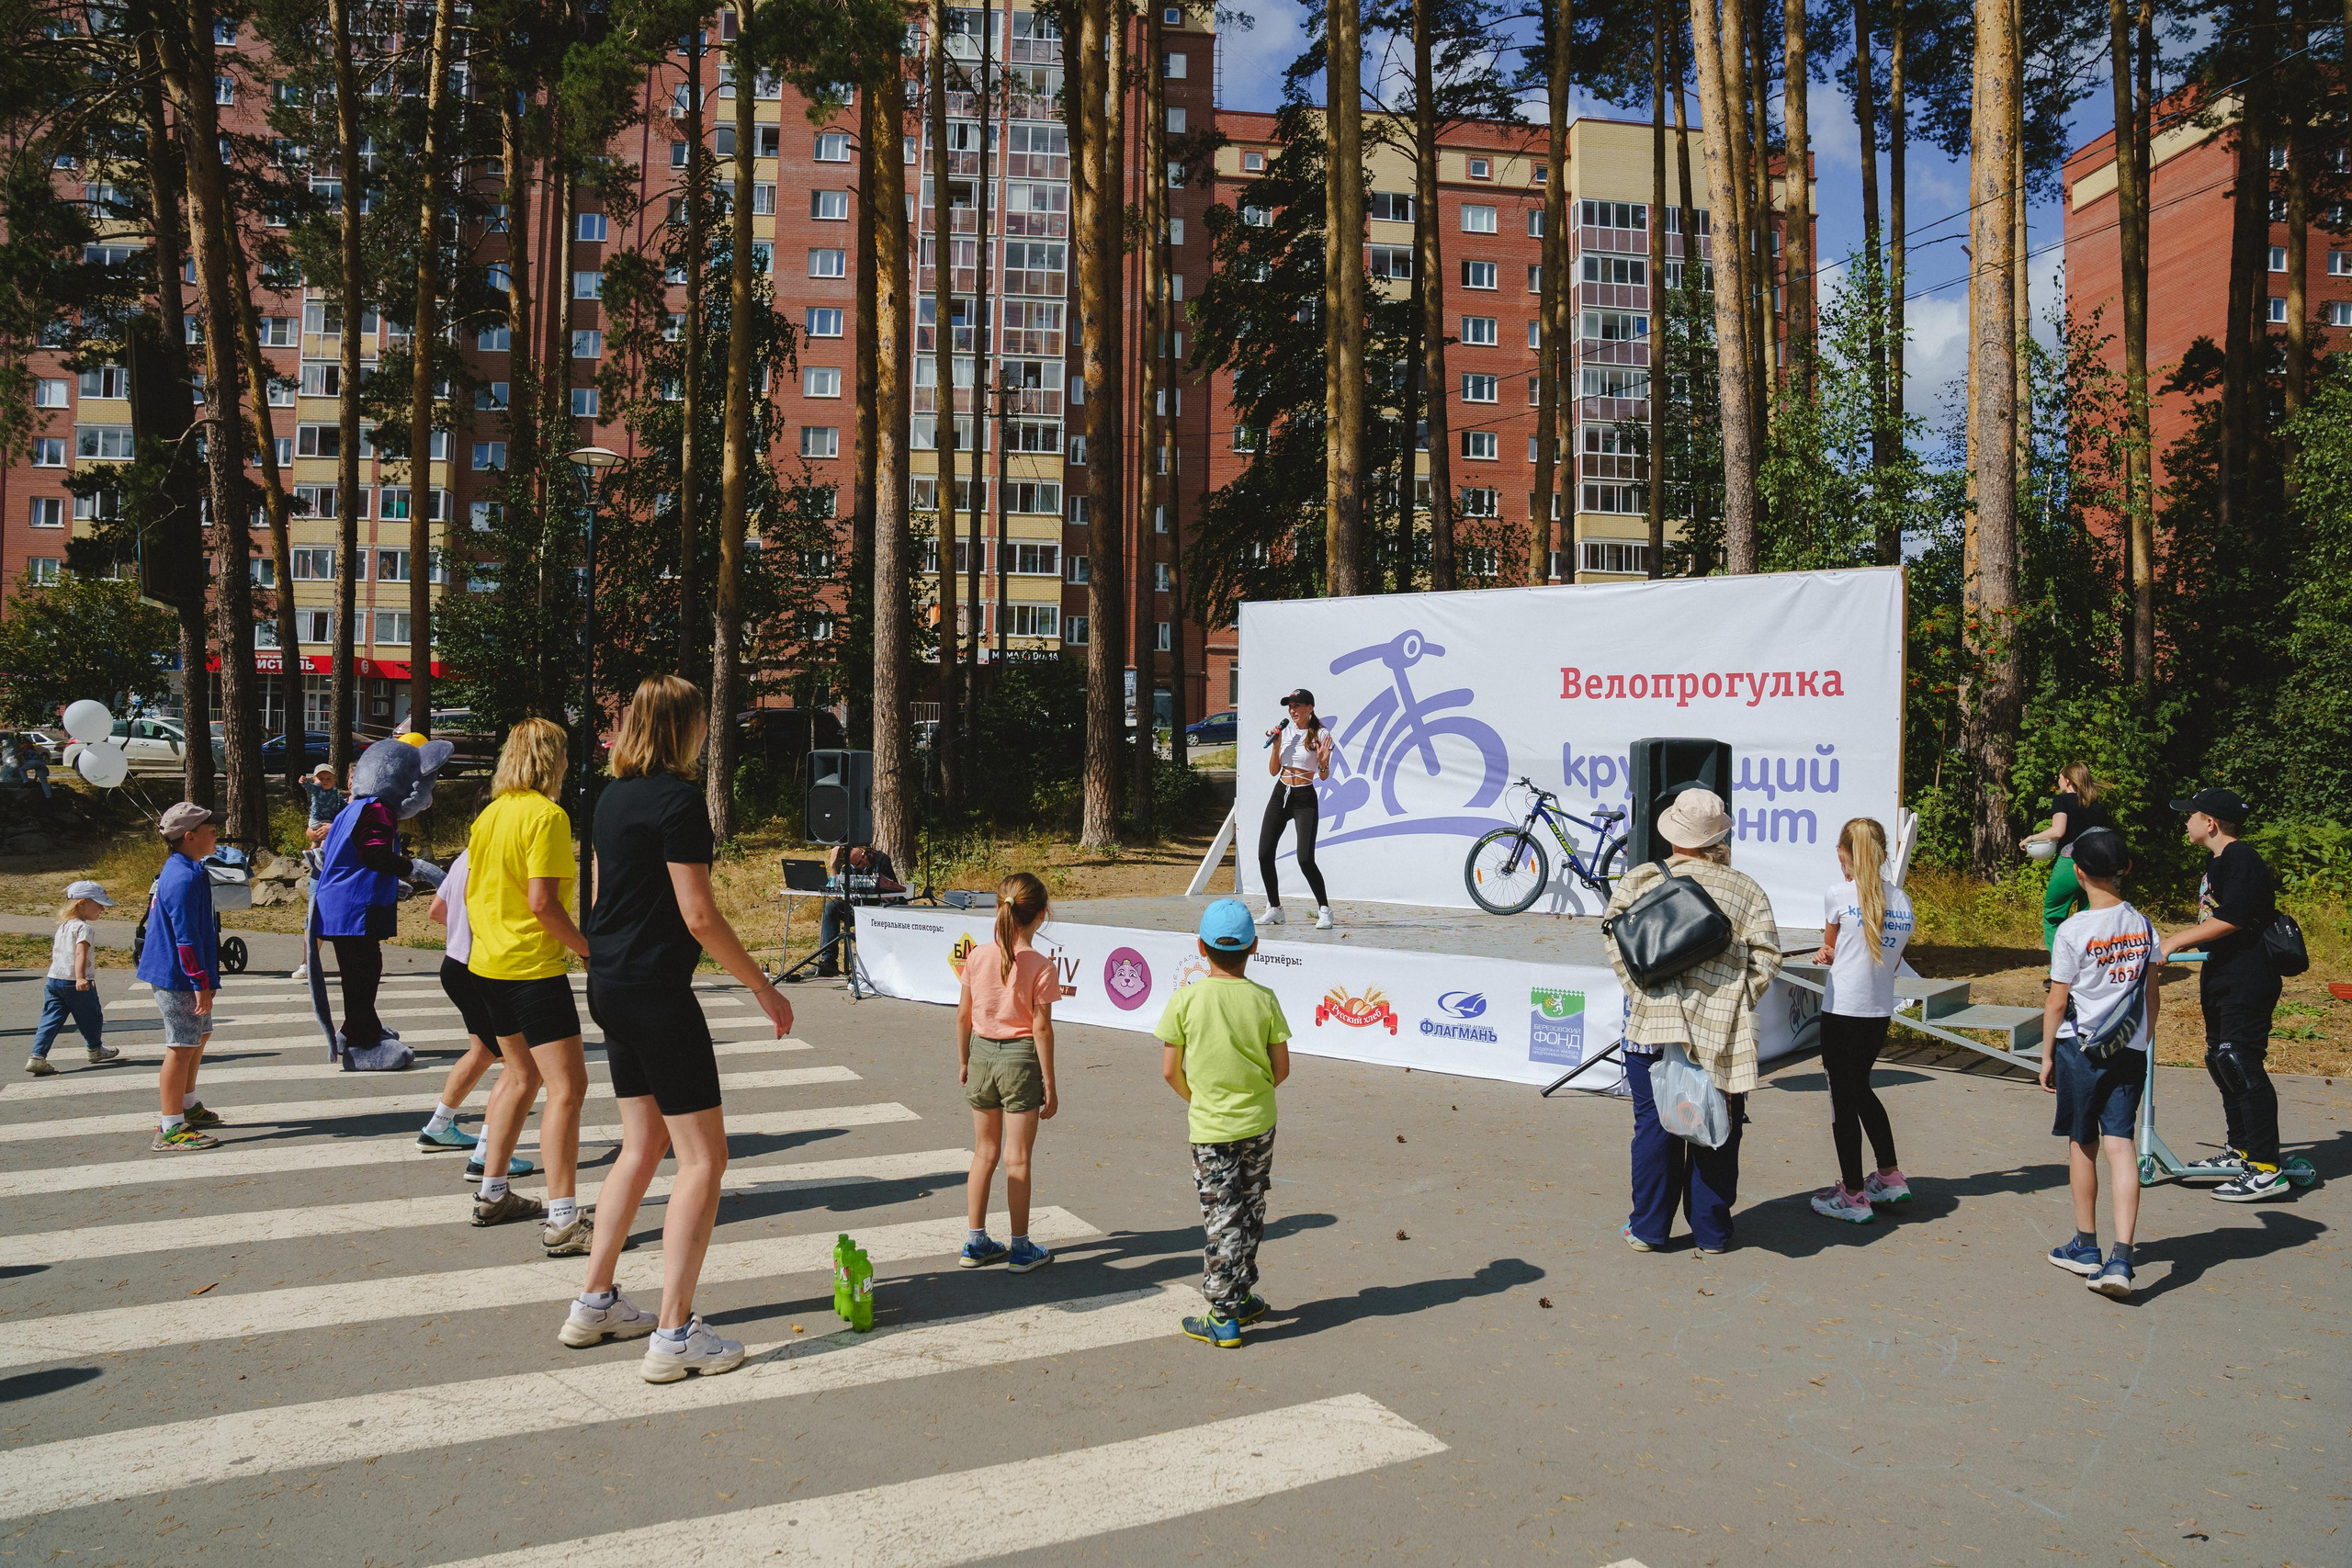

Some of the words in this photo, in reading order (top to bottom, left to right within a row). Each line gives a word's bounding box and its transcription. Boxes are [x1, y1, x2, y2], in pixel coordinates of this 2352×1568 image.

[1560, 667, 1845, 707] Велопрогулка
[1563, 741, 1840, 802] крущий
[871, 919, 910, 931] Генеральные
[911, 921, 944, 933] спонсоры:
[954, 939, 978, 960] БД
[1253, 952, 1303, 967] Партнёры:
[2109, 967, 2140, 984] 2022
[1331, 1003, 1363, 1025] Русский
[1363, 1008, 1382, 1025] хлеб
[1419, 1019, 1498, 1043] ФЛАГМАНЪ
[1533, 1023, 1581, 1034] БЕРЕЗОВСКИЙ
[1533, 1031, 1580, 1051] ФОНД
